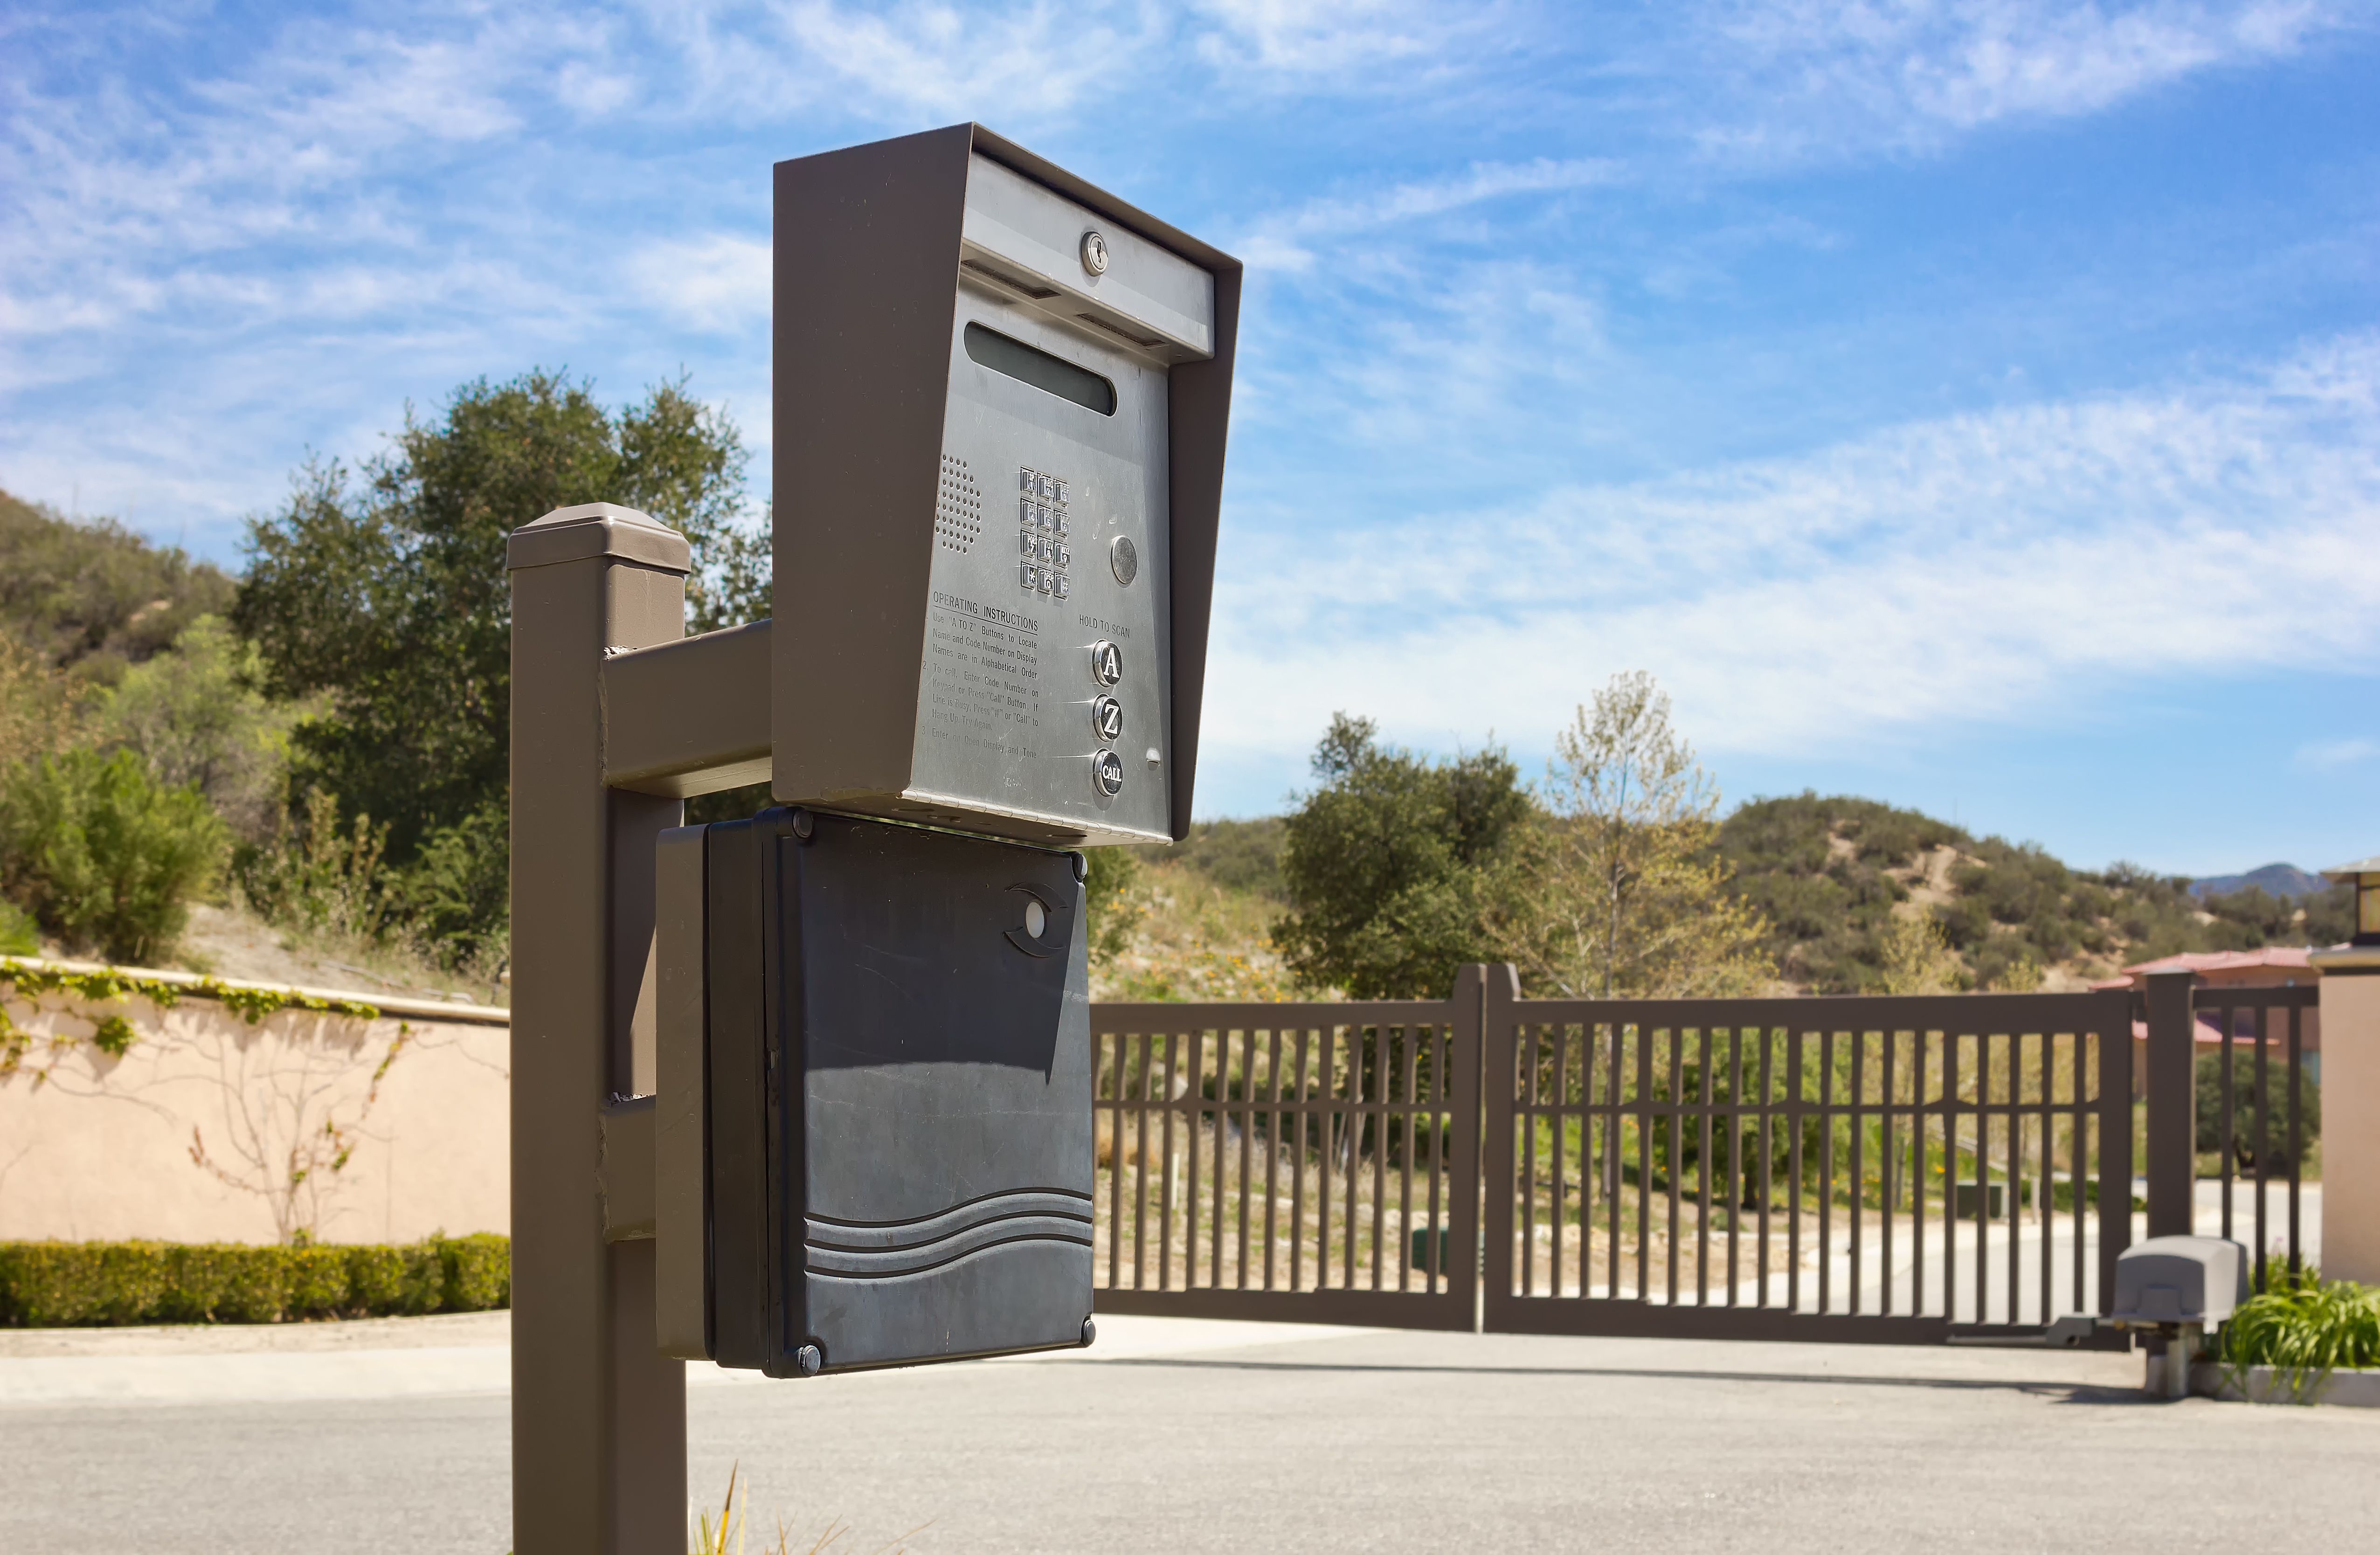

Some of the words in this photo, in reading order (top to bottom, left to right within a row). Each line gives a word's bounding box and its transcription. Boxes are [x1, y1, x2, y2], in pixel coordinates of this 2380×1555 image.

[1063, 554, 1067, 563] 9
[933, 591, 978, 614] OPERATING
[983, 605, 1038, 631] INSTRUCTIONS
[1079, 614, 1098, 629] HOLD
[1100, 620, 1109, 632] TO
[1112, 623, 1130, 639] SCAN
[933, 612, 944, 623] Use
[959, 619, 967, 630] TO
[982, 626, 1004, 640] Buttons
[1009, 634, 1014, 643] to
[1018, 636, 1037, 649] Locate
[933, 628, 950, 641] Name
[953, 634, 963, 645] and
[966, 637, 981, 649] Code
[983, 641, 1005, 656] Number
[1017, 650, 1037, 665] Display
[922, 660, 928, 670] 2.
[933, 663, 941, 674] To
[964, 671, 980, 683] Enter
[985, 676, 999, 688] Code
[1004, 681, 1026, 694] Number
[933, 643, 953, 657] Names
[958, 652, 968, 661] are
[972, 654, 977, 664] in
[981, 657, 1017, 674] Alphabetical
[1021, 667, 1038, 679] Order
[1103, 647, 1120, 678] A
[933, 678, 955, 692] Keypad
[958, 685, 965, 695] or
[968, 687, 984, 699] Press
[987, 692, 1004, 704] "Call"
[1034, 703, 1038, 712] If
[933, 693, 946, 705] Line
[948, 698, 953, 707] is
[974, 704, 990, 716] Press
[1014, 712, 1031, 724] "Call"
[1033, 718, 1038, 726] to
[933, 709, 948, 723] Hang
[962, 715, 972, 728] Try
[1104, 703, 1119, 735] Z
[933, 727, 948, 739] Enter
[964, 735, 980, 747] Open
[983, 739, 1004, 754] Display
[1008, 746, 1018, 755] and
[1023, 747, 1037, 759] Tone
[1102, 765, 1122, 782] CALL
